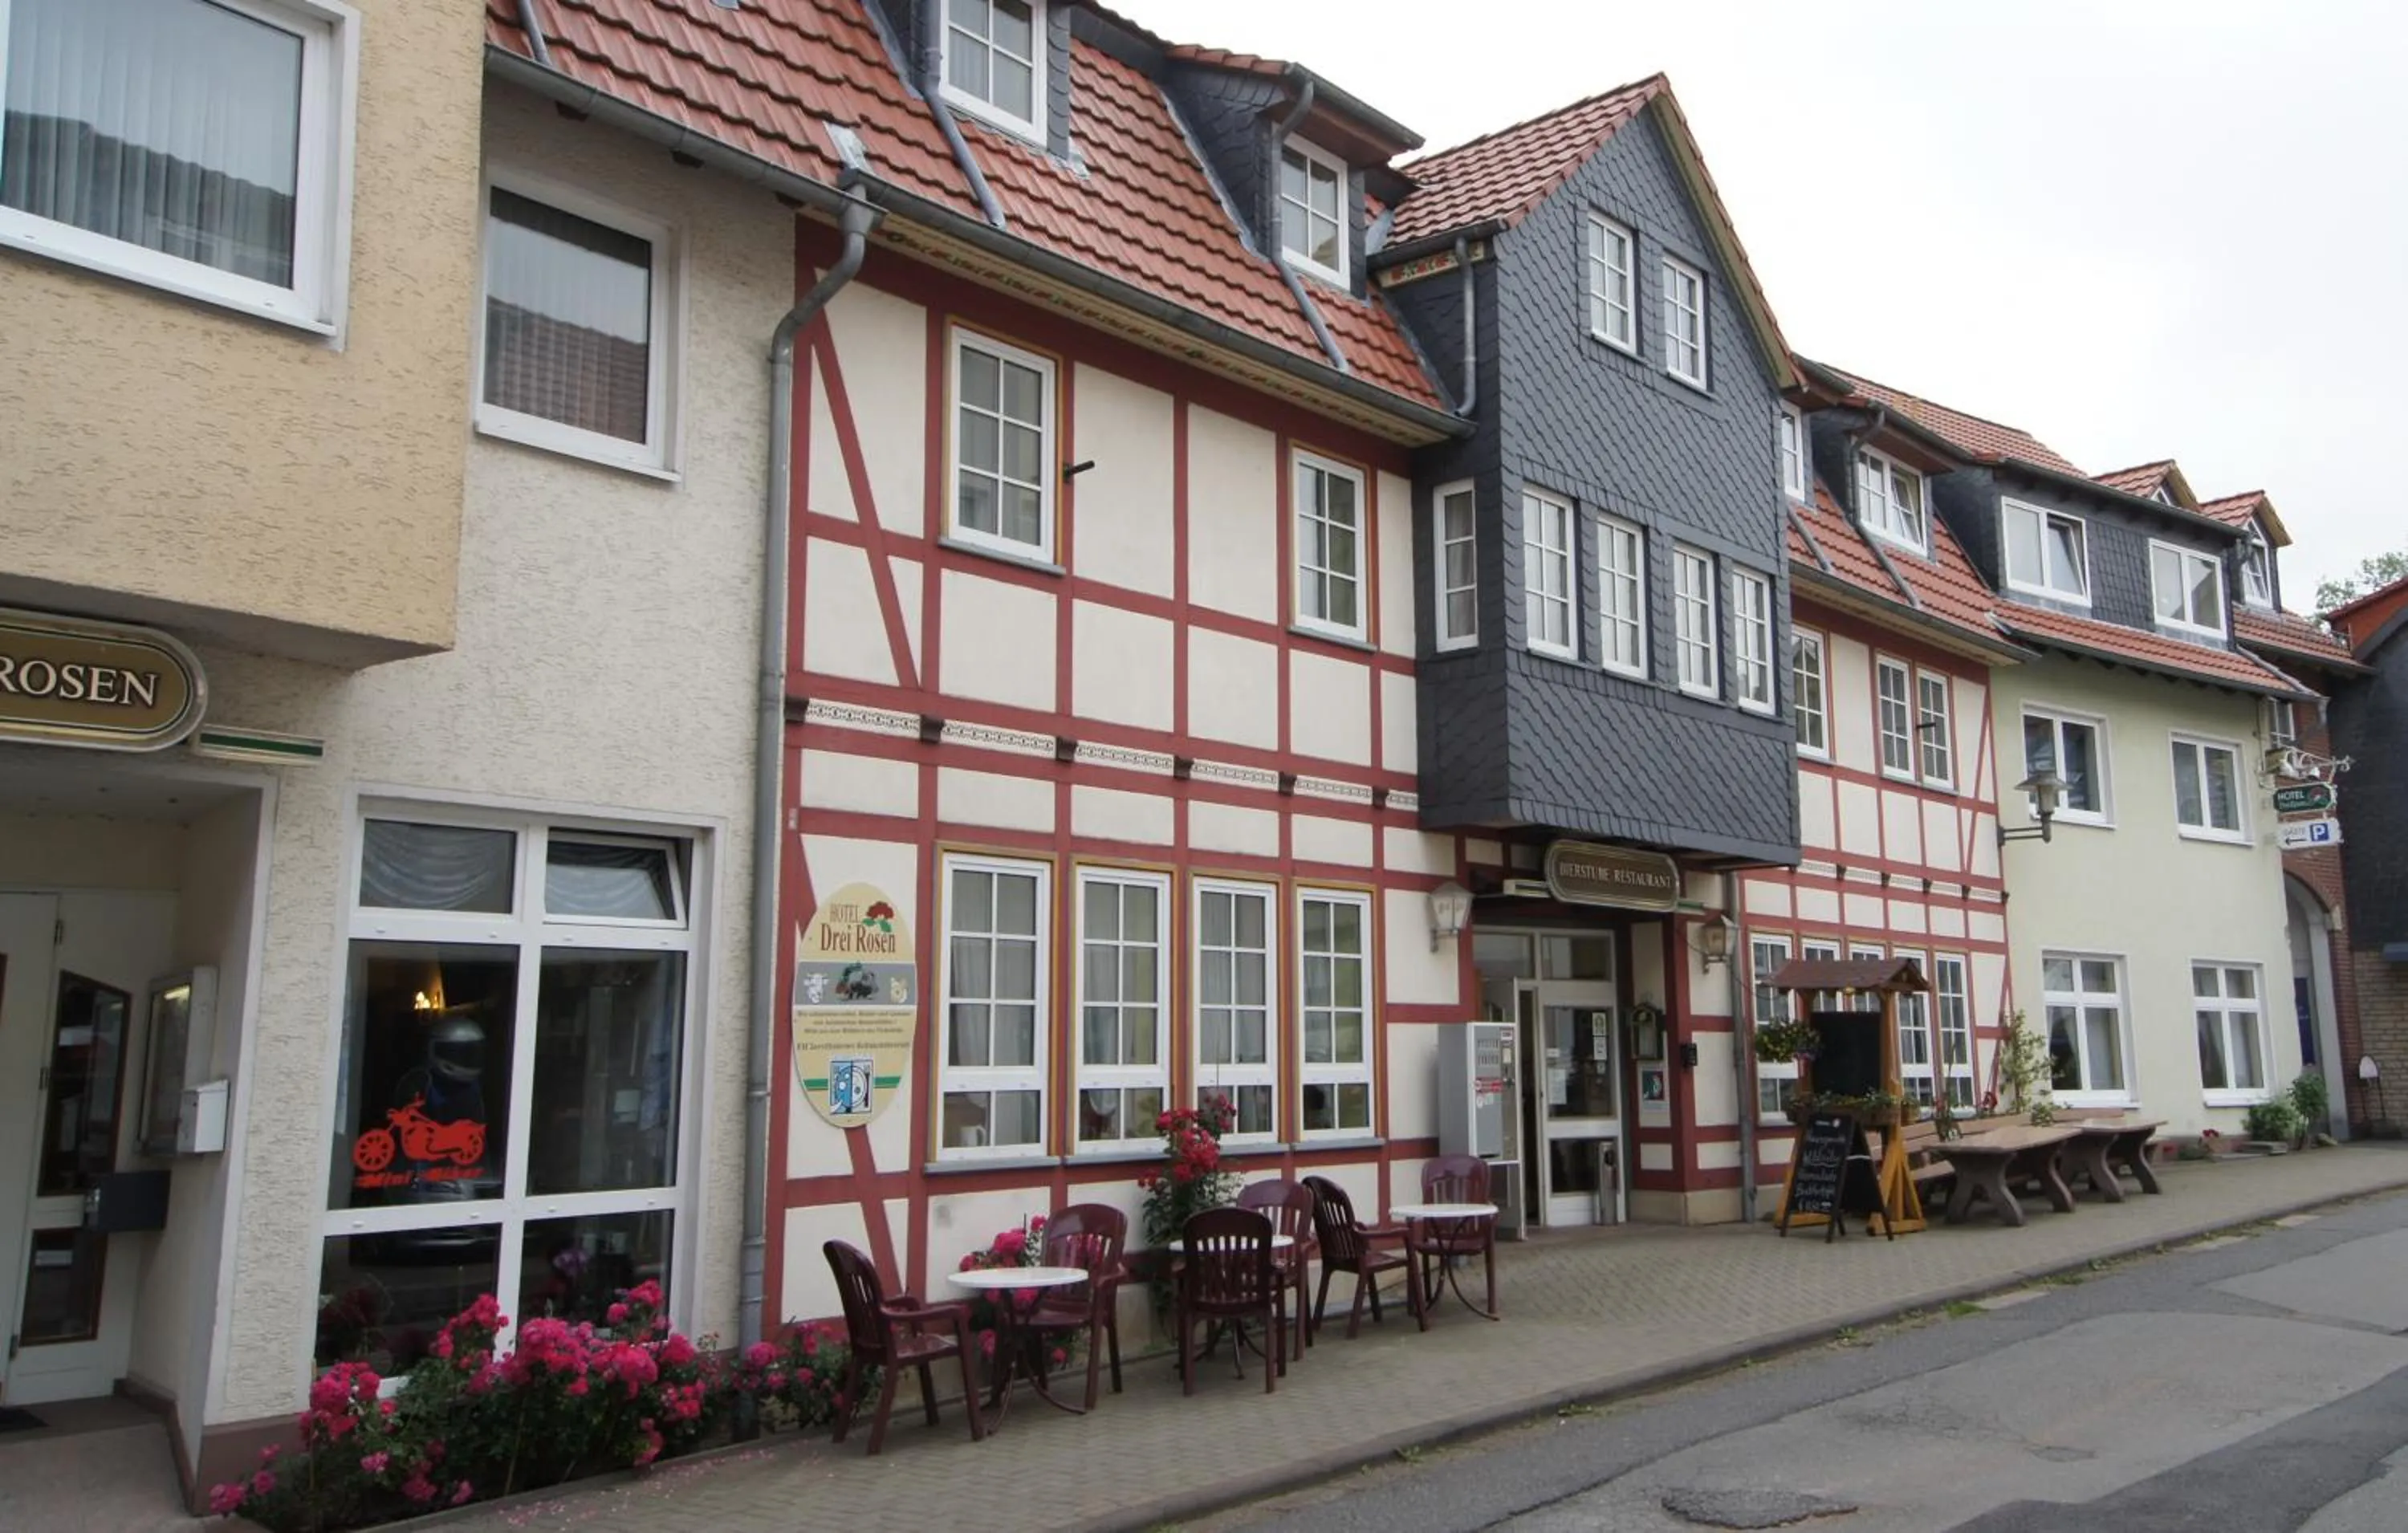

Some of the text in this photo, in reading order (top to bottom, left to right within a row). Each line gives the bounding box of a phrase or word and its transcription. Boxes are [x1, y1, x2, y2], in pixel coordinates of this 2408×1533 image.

[0, 656, 158, 706] ROSEN
[2278, 791, 2305, 801] HOTEL
[1613, 869, 1671, 888] RESTAURANT
[830, 904, 860, 923] HOTEL
[820, 923, 896, 954] Drei Rosen
